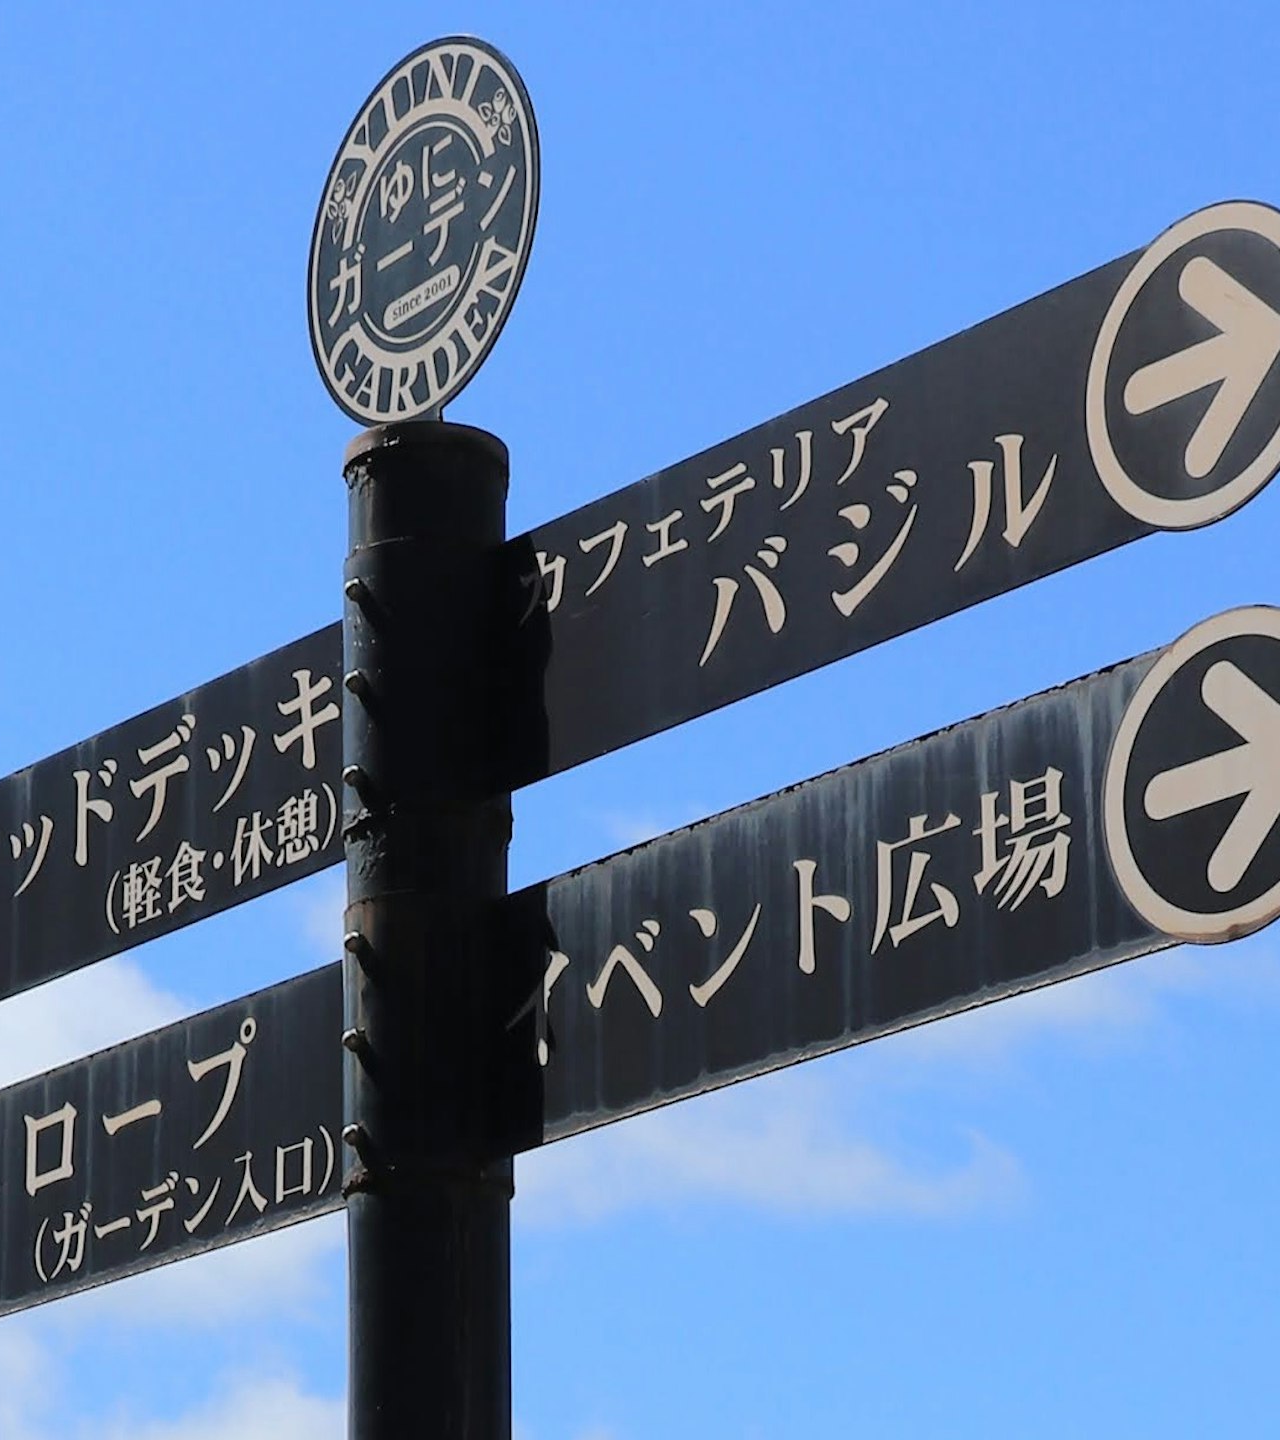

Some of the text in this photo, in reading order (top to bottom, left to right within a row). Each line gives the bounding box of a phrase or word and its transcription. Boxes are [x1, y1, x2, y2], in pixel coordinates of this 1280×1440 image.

[342, 48, 486, 164] YUNI
[381, 134, 456, 224] ゆに
[328, 165, 517, 328] ガーデン
[392, 274, 453, 321] since 2001
[329, 235, 518, 416] GARDEN
[698, 433, 1058, 668] バジル
[105, 782, 338, 935] (軽食・休憩)
[34, 1125, 335, 1283] (ガーデン入口)
